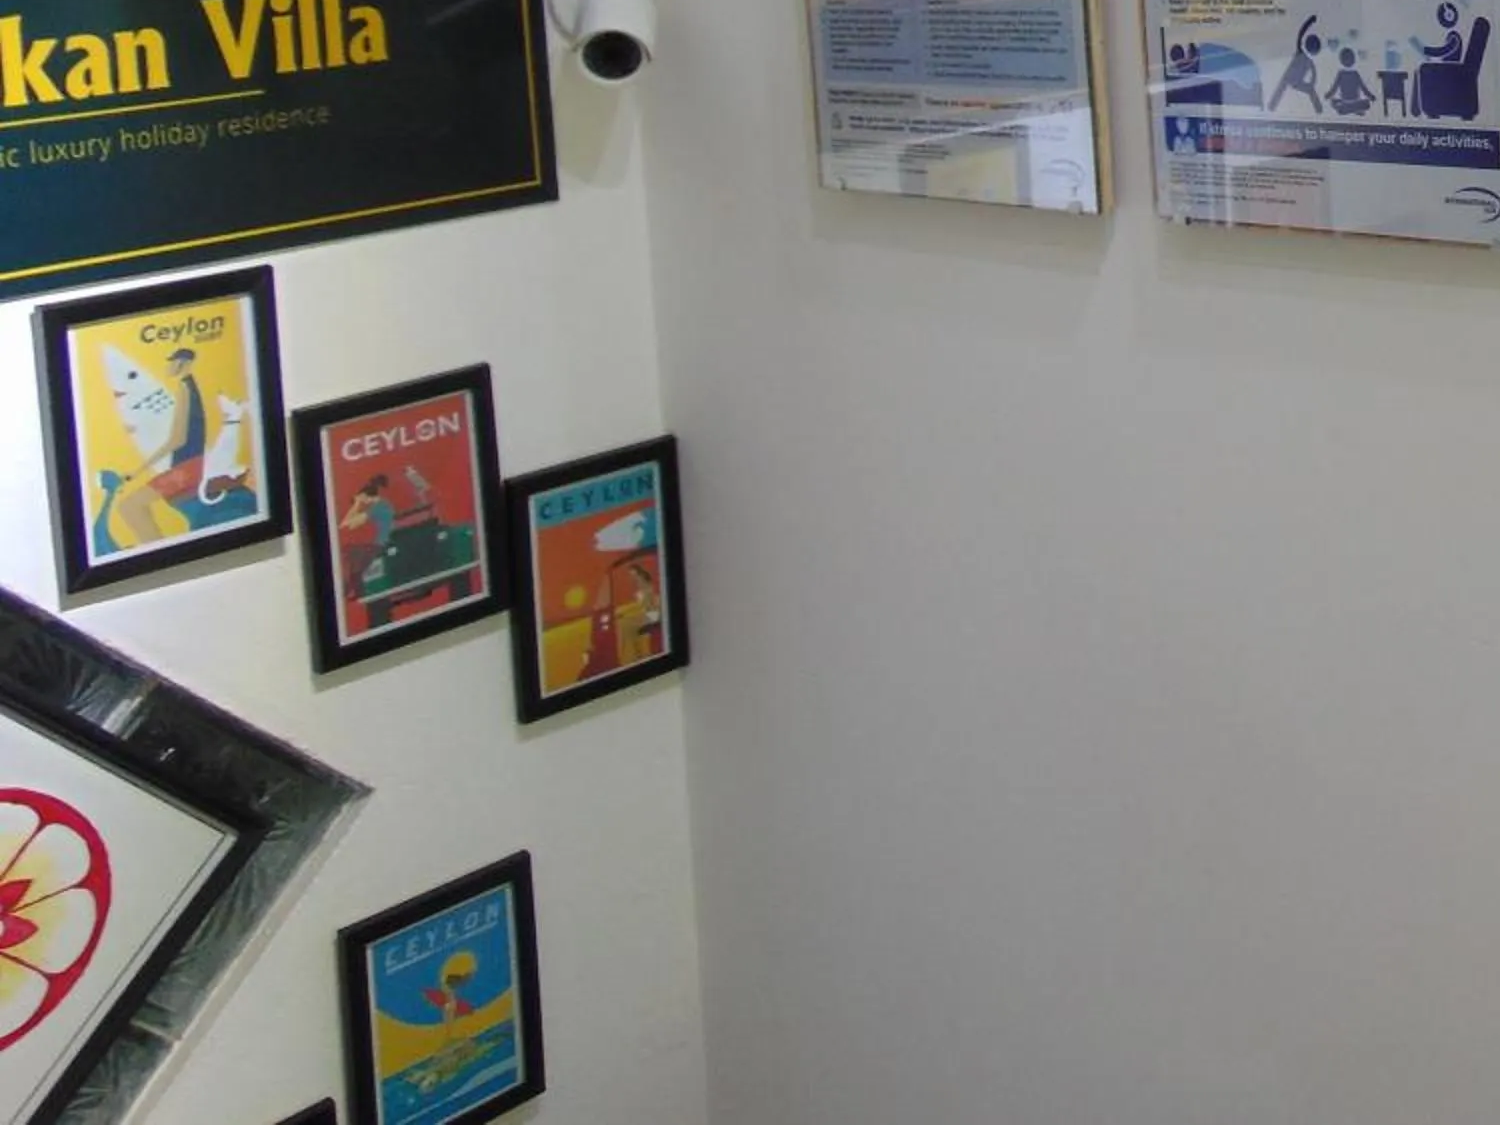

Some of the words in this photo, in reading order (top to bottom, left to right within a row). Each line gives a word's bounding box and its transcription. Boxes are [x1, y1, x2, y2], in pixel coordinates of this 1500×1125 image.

[0, 13, 172, 107] kan
[28, 136, 111, 164] luxury
[119, 119, 209, 152] holiday
[217, 106, 333, 139] residence
[1305, 128, 1318, 140] to
[1368, 132, 1397, 146] your
[1399, 132, 1429, 149] daily
[140, 315, 225, 344] Ceylon
[341, 412, 461, 461] CEYLON
[539, 472, 654, 521] CEYLON
[385, 901, 500, 969] CEYLON
